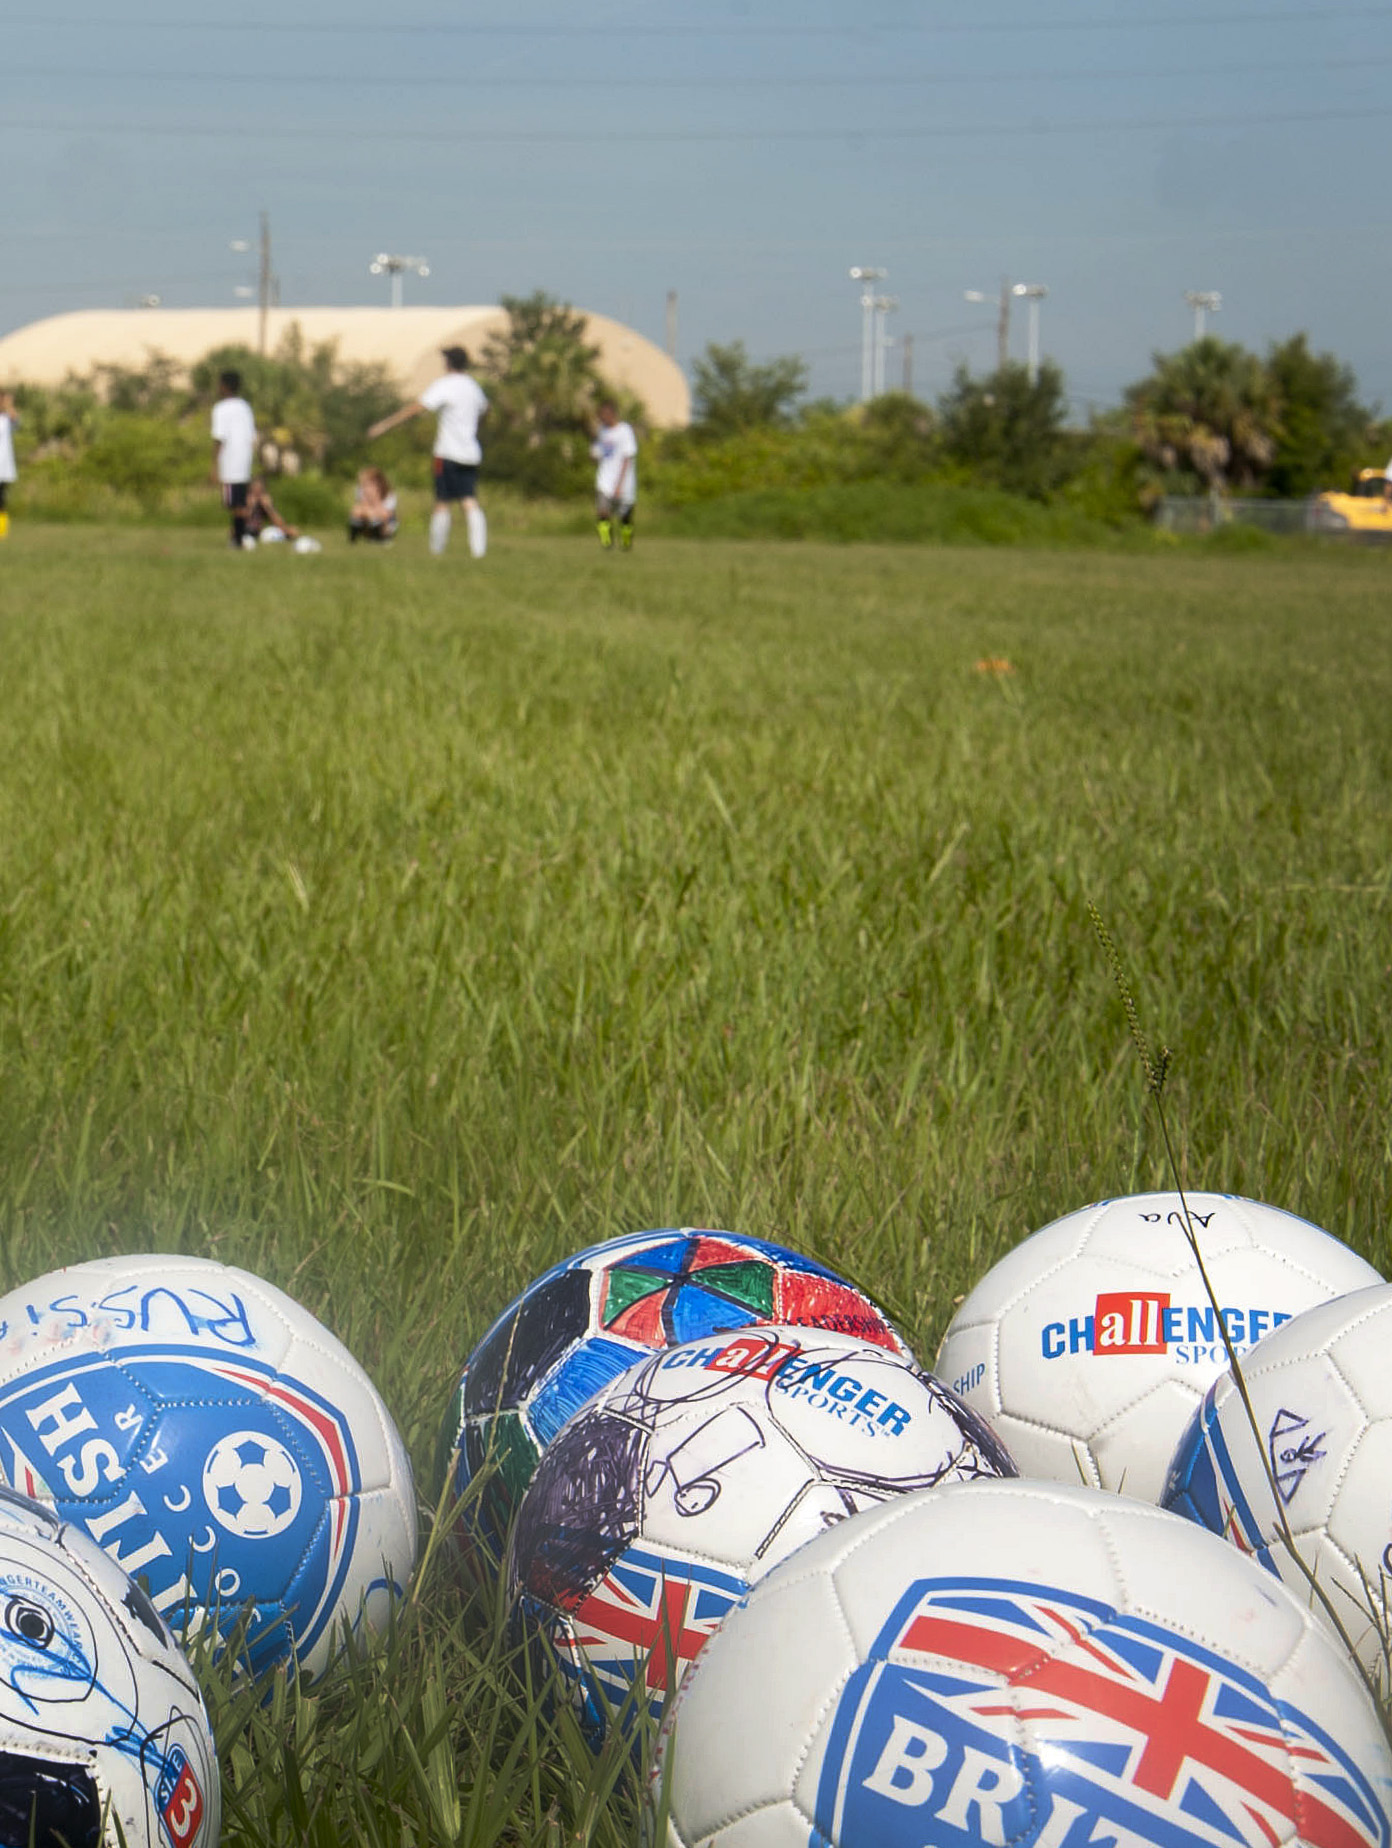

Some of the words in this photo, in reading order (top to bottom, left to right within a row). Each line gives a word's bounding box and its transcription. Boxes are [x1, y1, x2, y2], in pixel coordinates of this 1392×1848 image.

[774, 1382, 877, 1438] SPORTS
[114, 1402, 262, 1628] OCCER
[170, 1777, 198, 1839] 3
